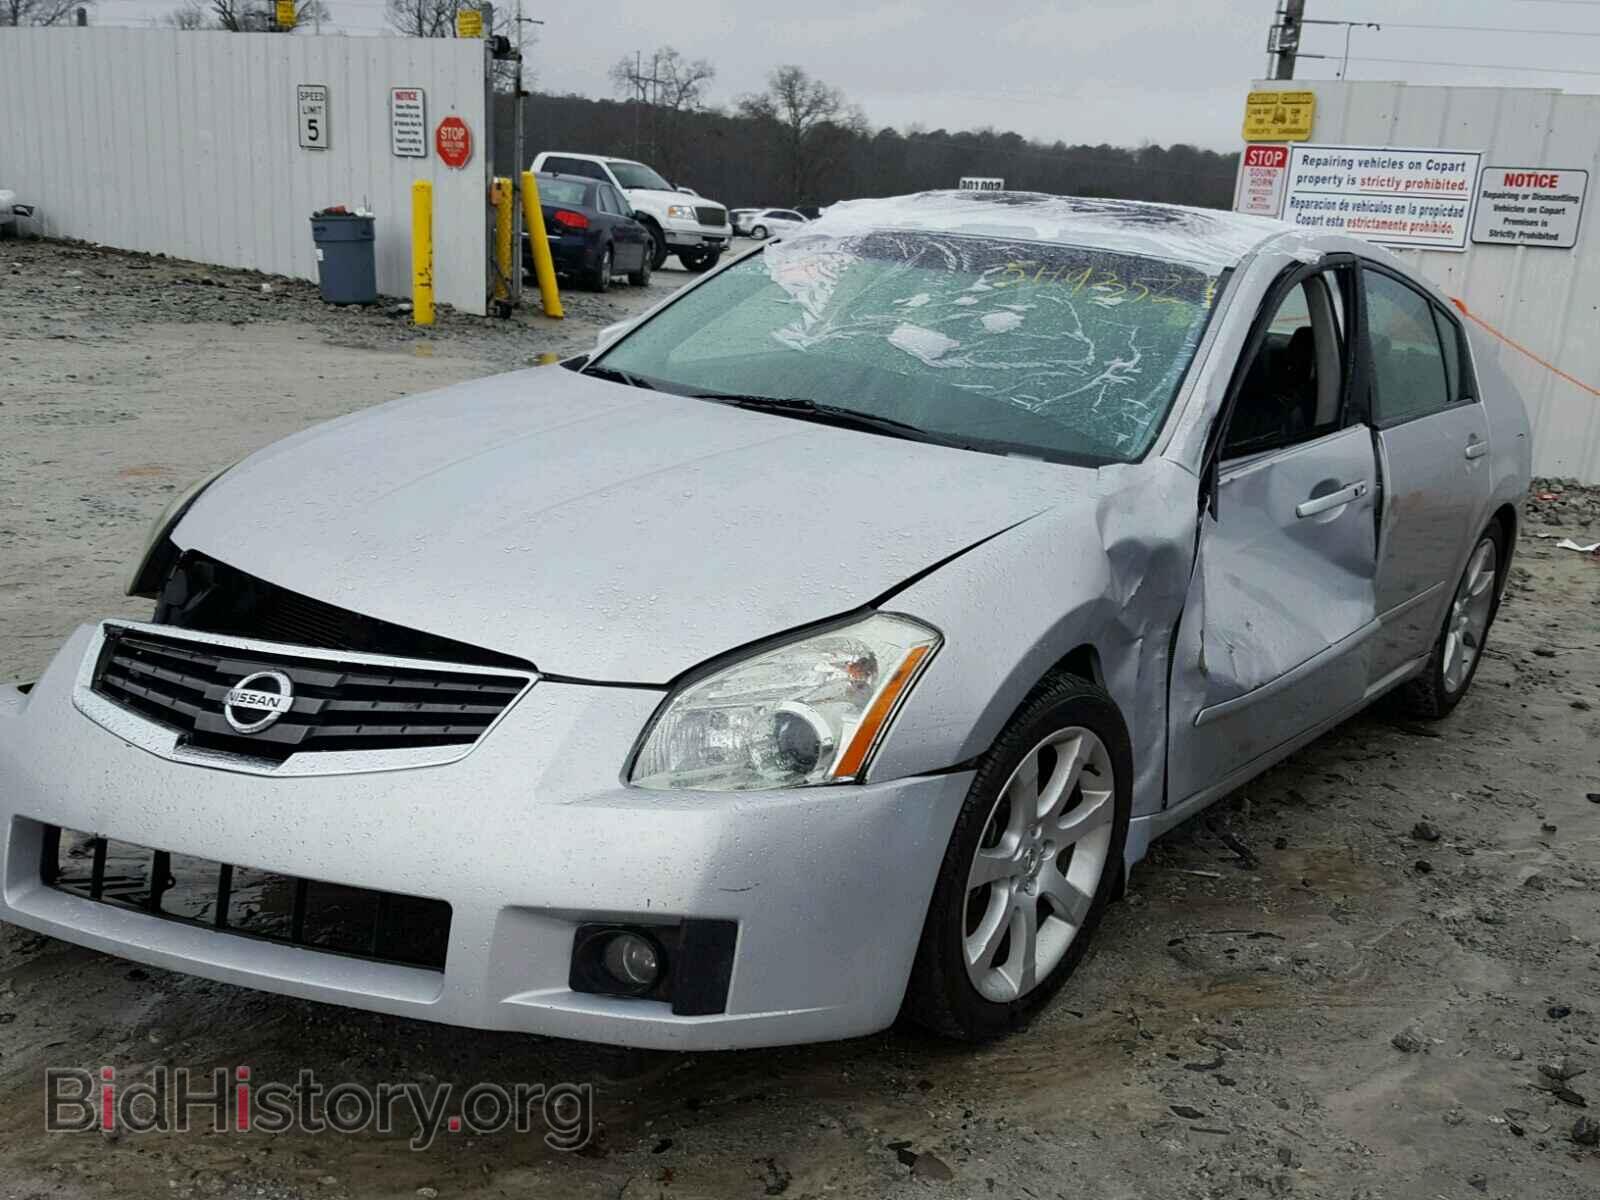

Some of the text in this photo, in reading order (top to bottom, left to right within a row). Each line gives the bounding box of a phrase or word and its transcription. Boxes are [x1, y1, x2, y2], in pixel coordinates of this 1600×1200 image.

[300, 91, 325, 101] SPEED
[302, 105, 321, 115] LIMIT
[308, 119, 319, 141] 5
[440, 127, 465, 140] STOP
[1248, 150, 1283, 166] STOP
[1302, 154, 1466, 174] Repairing vehicles on Copart
[1296, 174, 1468, 192] property is strictly prohibited.
[1503, 173, 1559, 188] NOTICE
[1482, 191, 1519, 201] Repairing
[1532, 193, 1579, 204] Dismantling
[1339, 199, 1349, 211] de
[1395, 204, 1406, 214] en
[1408, 202, 1417, 215] la
[1493, 204, 1525, 213] Vehicles
[1539, 206, 1565, 216] Copart
[1296, 213, 1324, 226] Copart
[1326, 216, 1344, 228] esta
[1347, 217, 1406, 232] estrictamente
[1503, 217, 1538, 226] Premises
[1489, 229, 1559, 240] Strictly Prohibited
[229, 691, 281, 708] NISSAN
